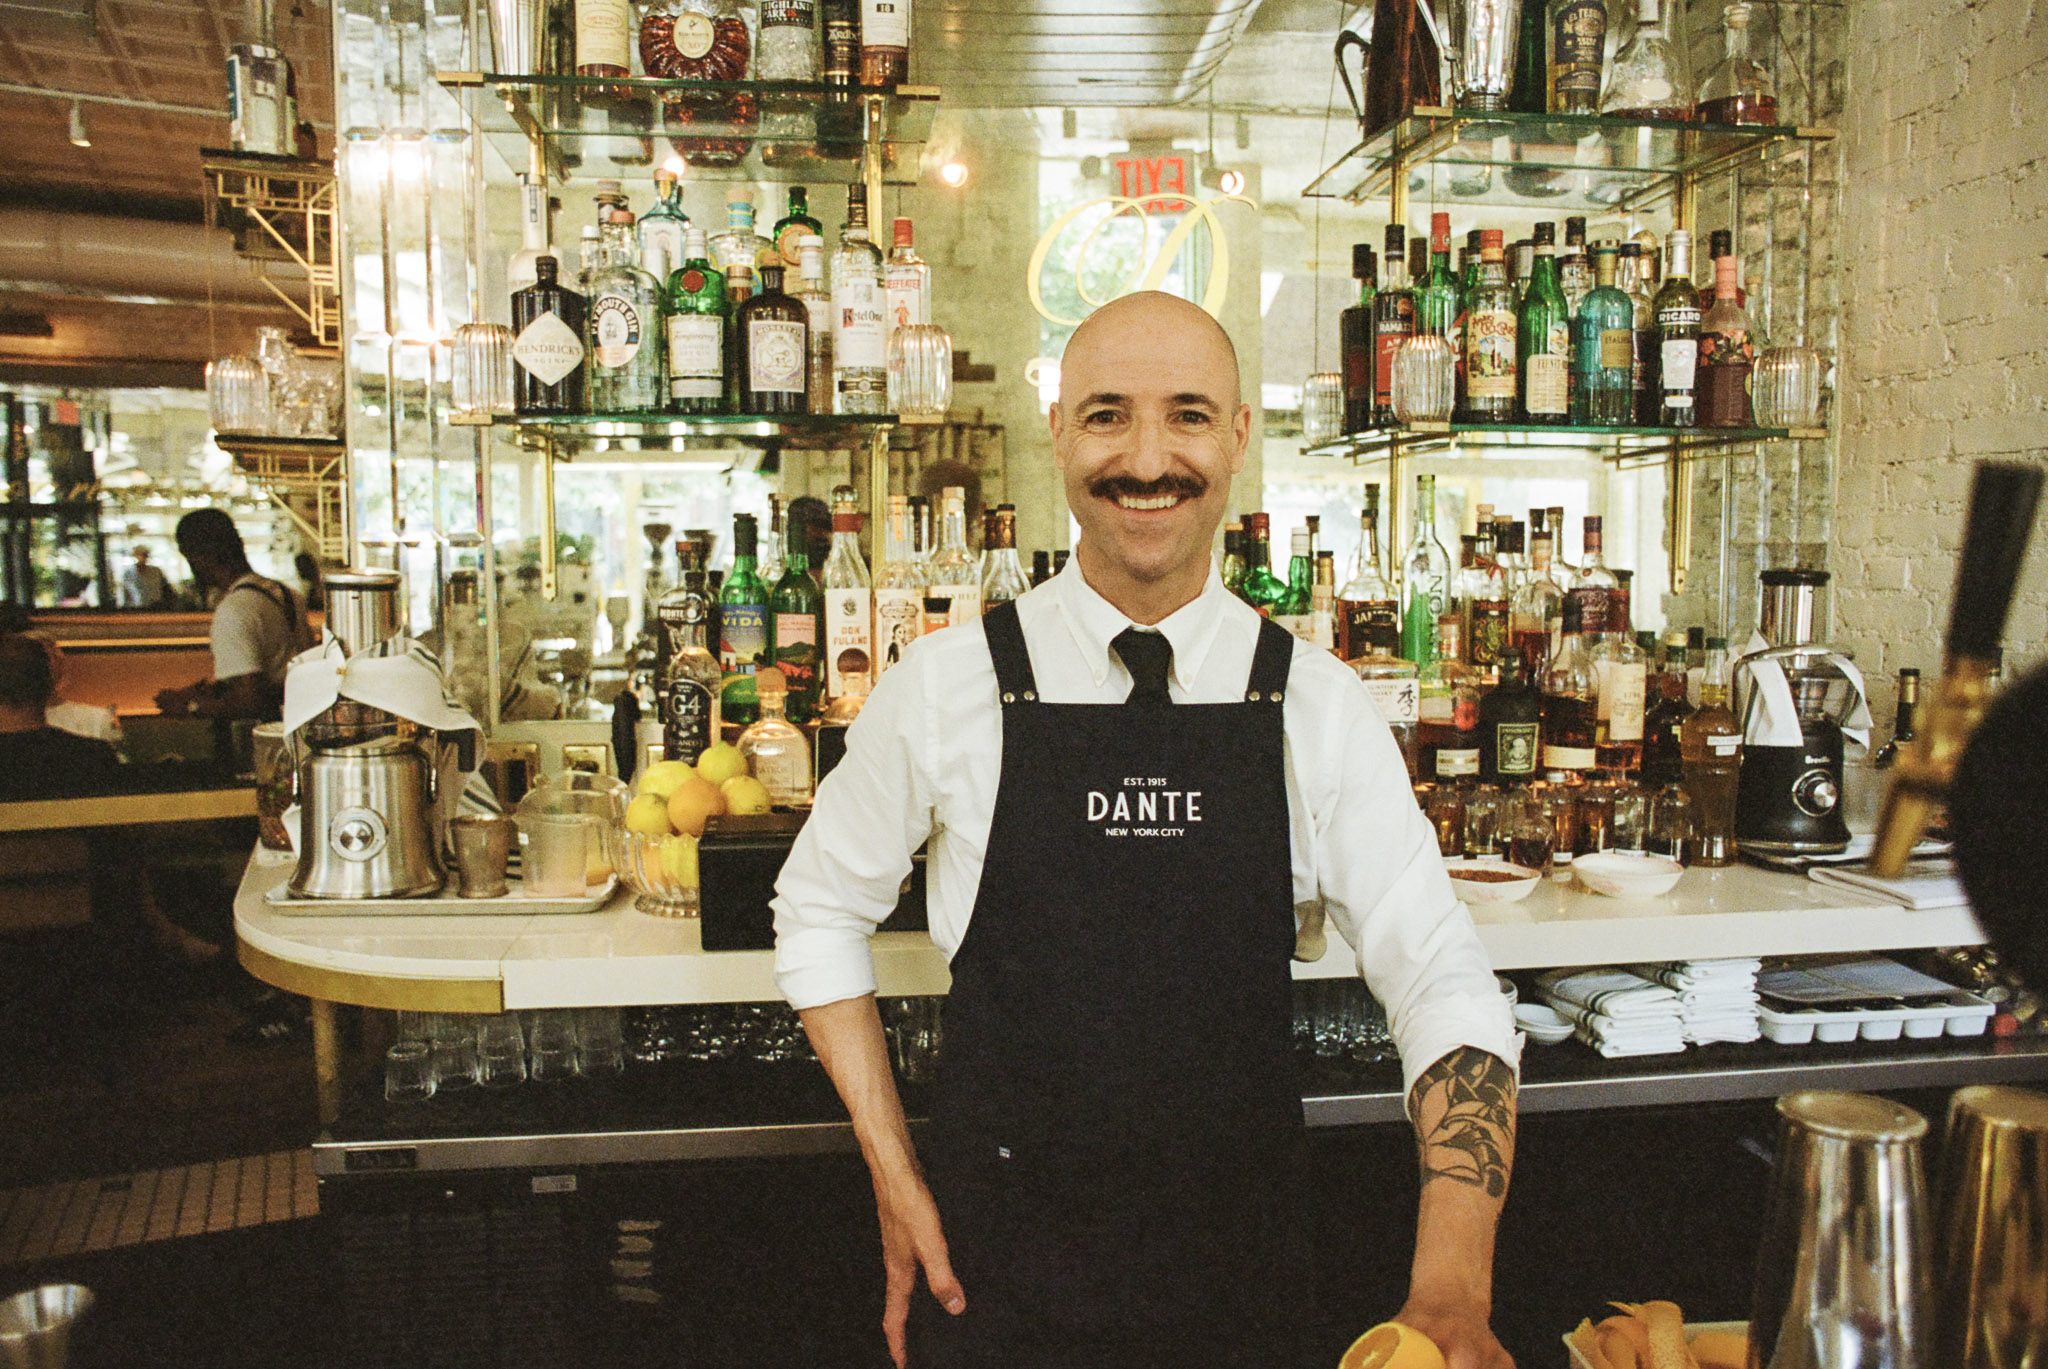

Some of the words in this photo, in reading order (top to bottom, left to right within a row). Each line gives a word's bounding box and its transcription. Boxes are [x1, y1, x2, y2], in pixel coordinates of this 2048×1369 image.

[1658, 311, 1701, 322] RICARD
[722, 616, 763, 627] VIDA
[672, 694, 701, 715] G4
[1123, 777, 1146, 786] EST.
[1147, 777, 1168, 786] 1915
[1087, 791, 1202, 822] DANTE
[1105, 828, 1129, 837] NEW
[1132, 828, 1160, 837] YORK
[1160, 828, 1185, 837] CITY
